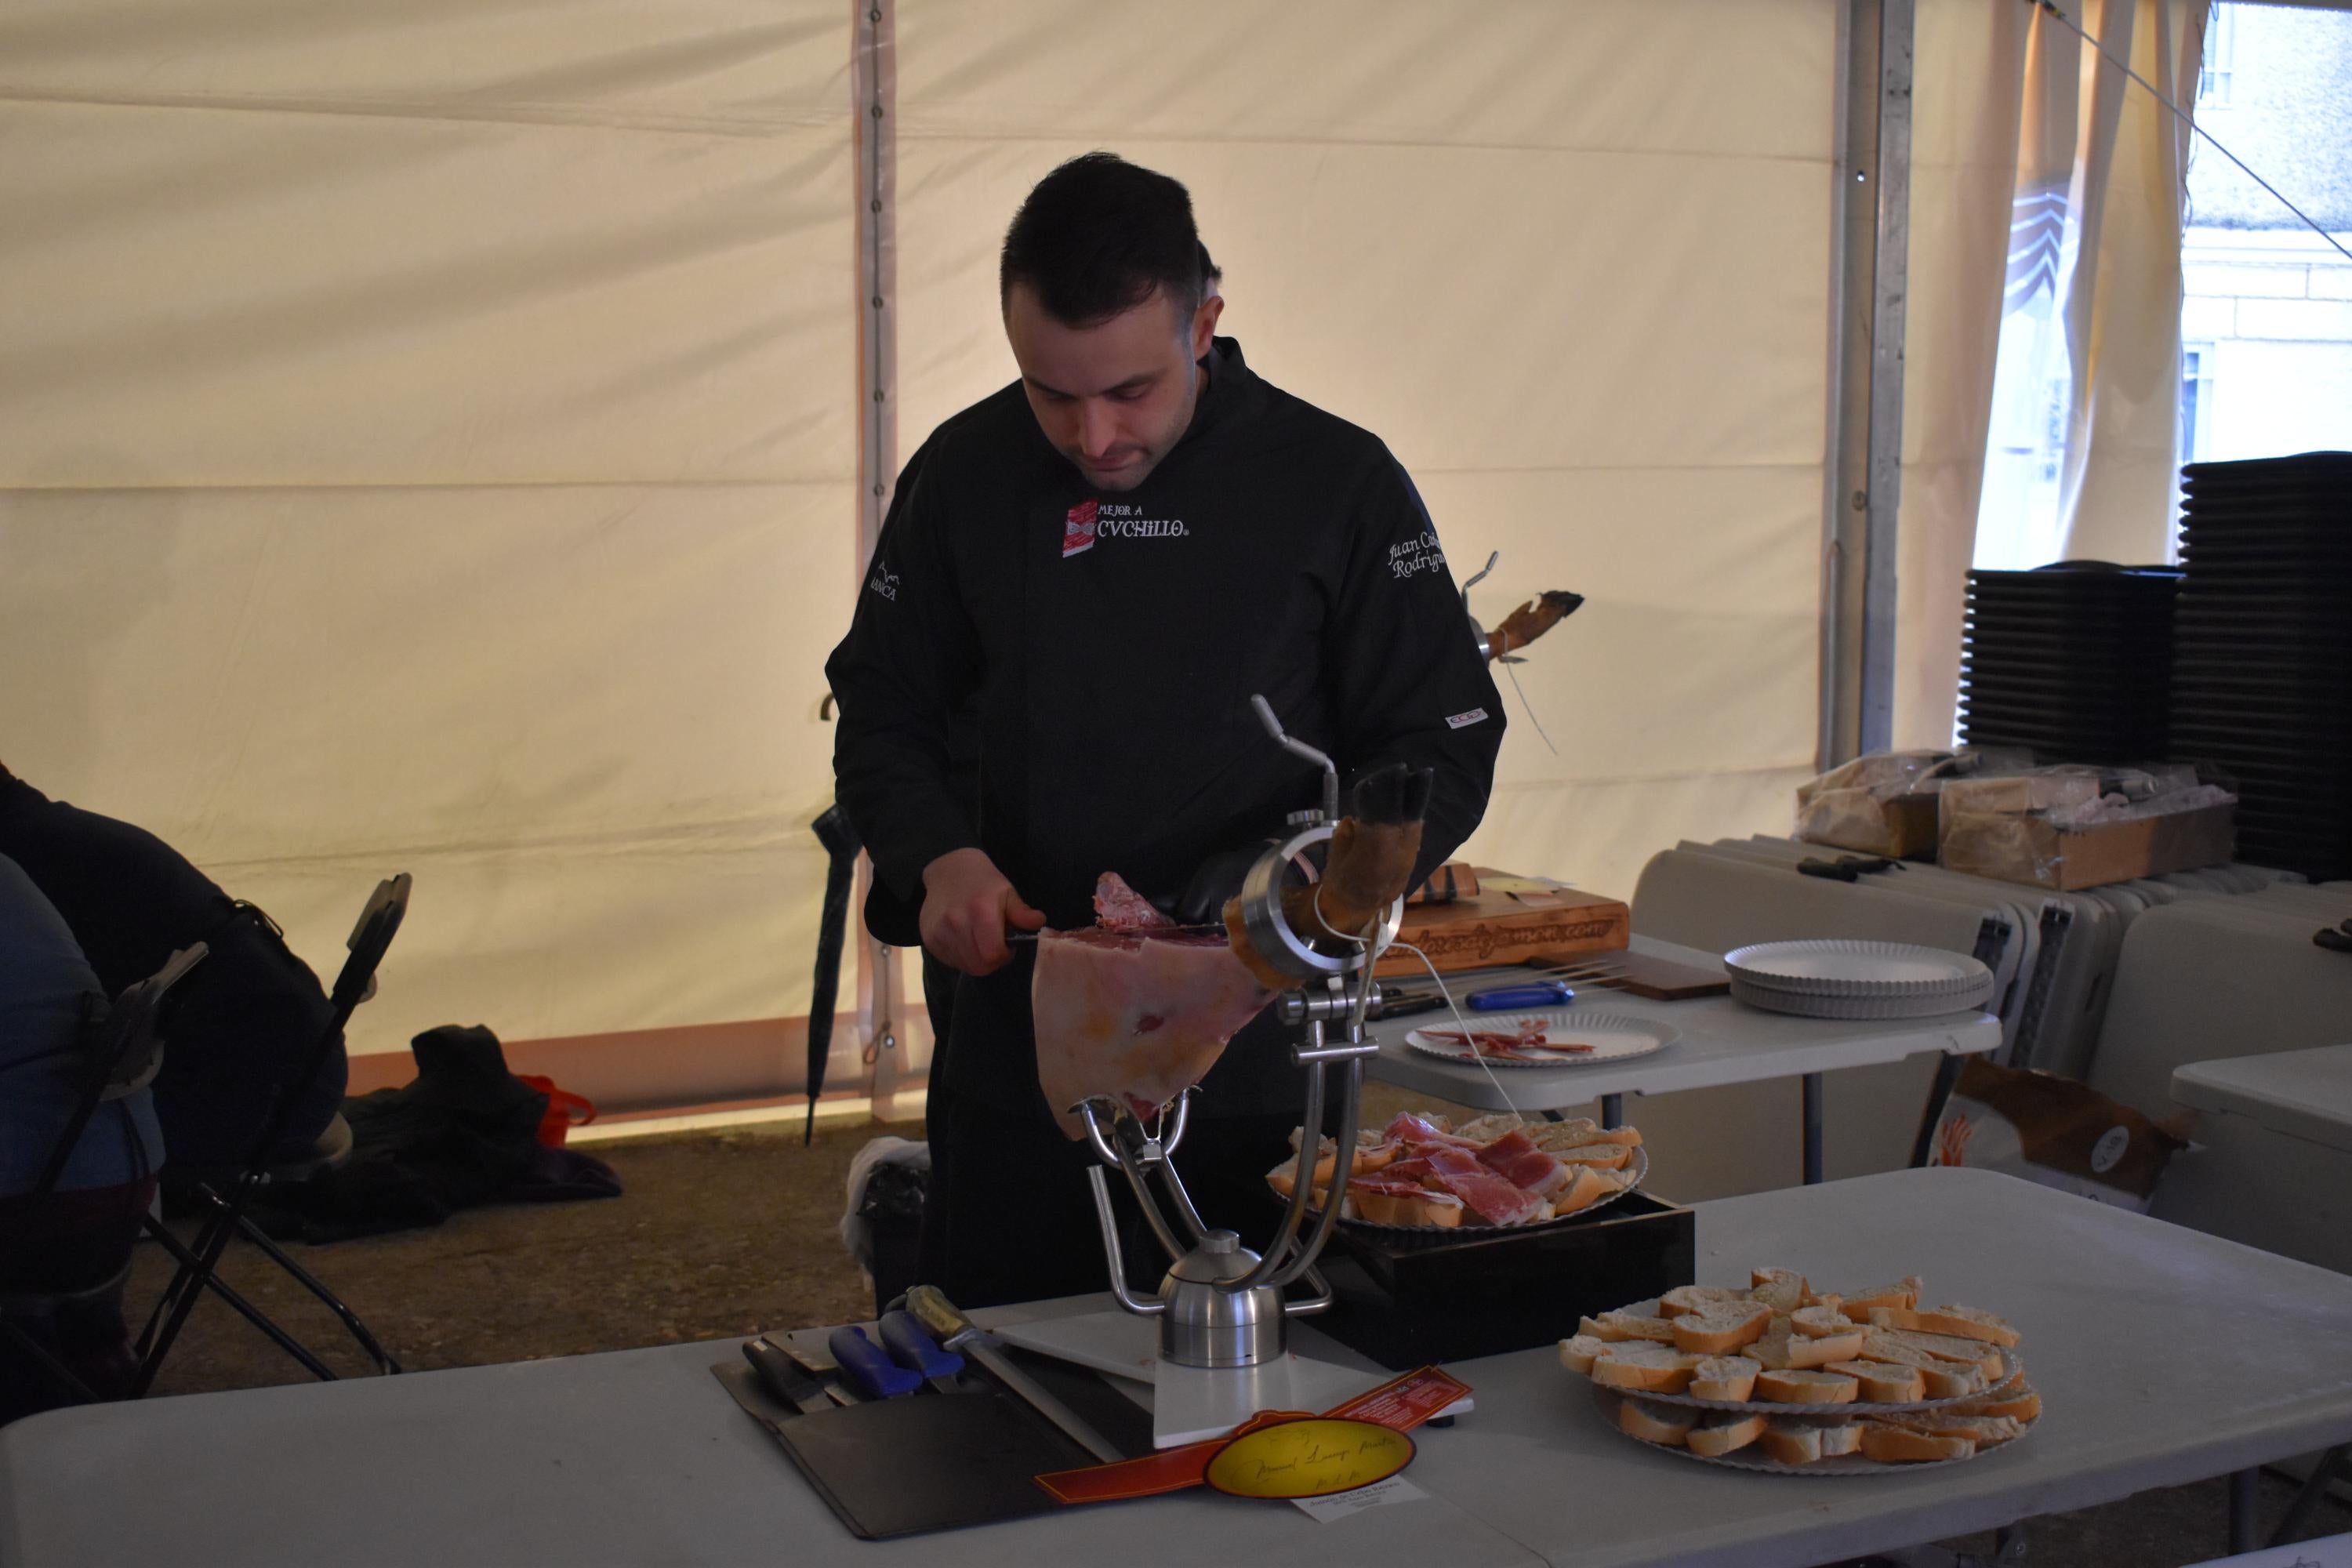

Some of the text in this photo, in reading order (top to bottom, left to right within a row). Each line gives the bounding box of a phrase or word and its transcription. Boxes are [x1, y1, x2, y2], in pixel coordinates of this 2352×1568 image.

[1098, 504, 1143, 517] MEJOR A
[1388, 539, 1421, 566] Juan
